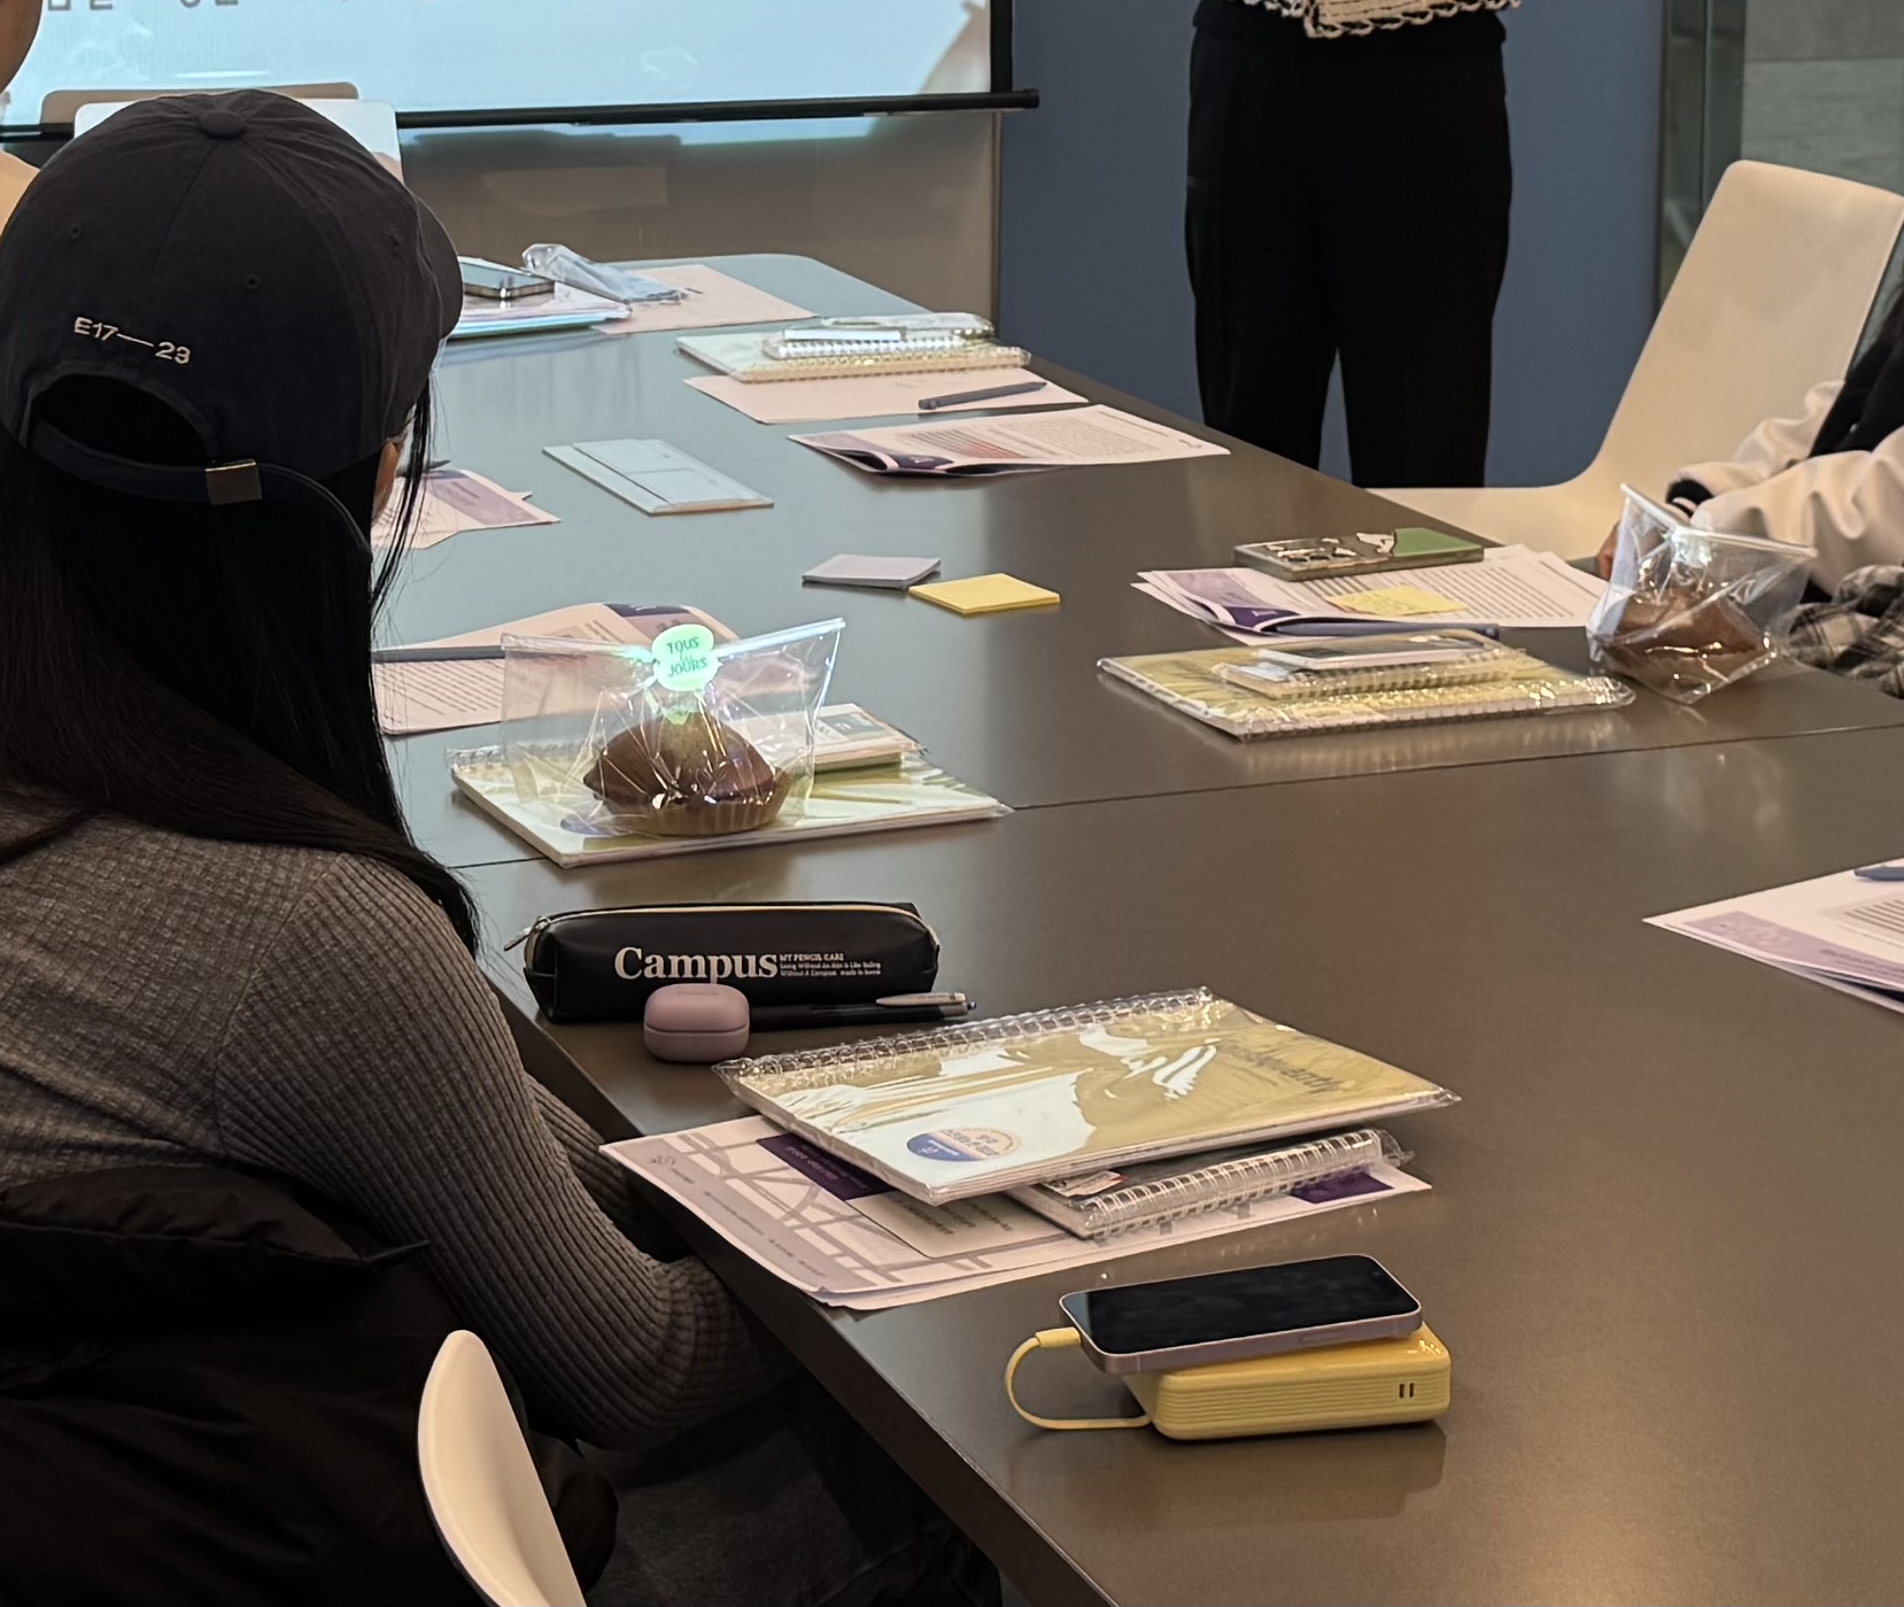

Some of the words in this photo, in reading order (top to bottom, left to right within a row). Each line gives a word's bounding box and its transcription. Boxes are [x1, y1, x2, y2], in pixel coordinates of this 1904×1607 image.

[666, 636, 700, 654] TOUS
[668, 657, 709, 677] JOURS
[614, 946, 778, 984] Campus
